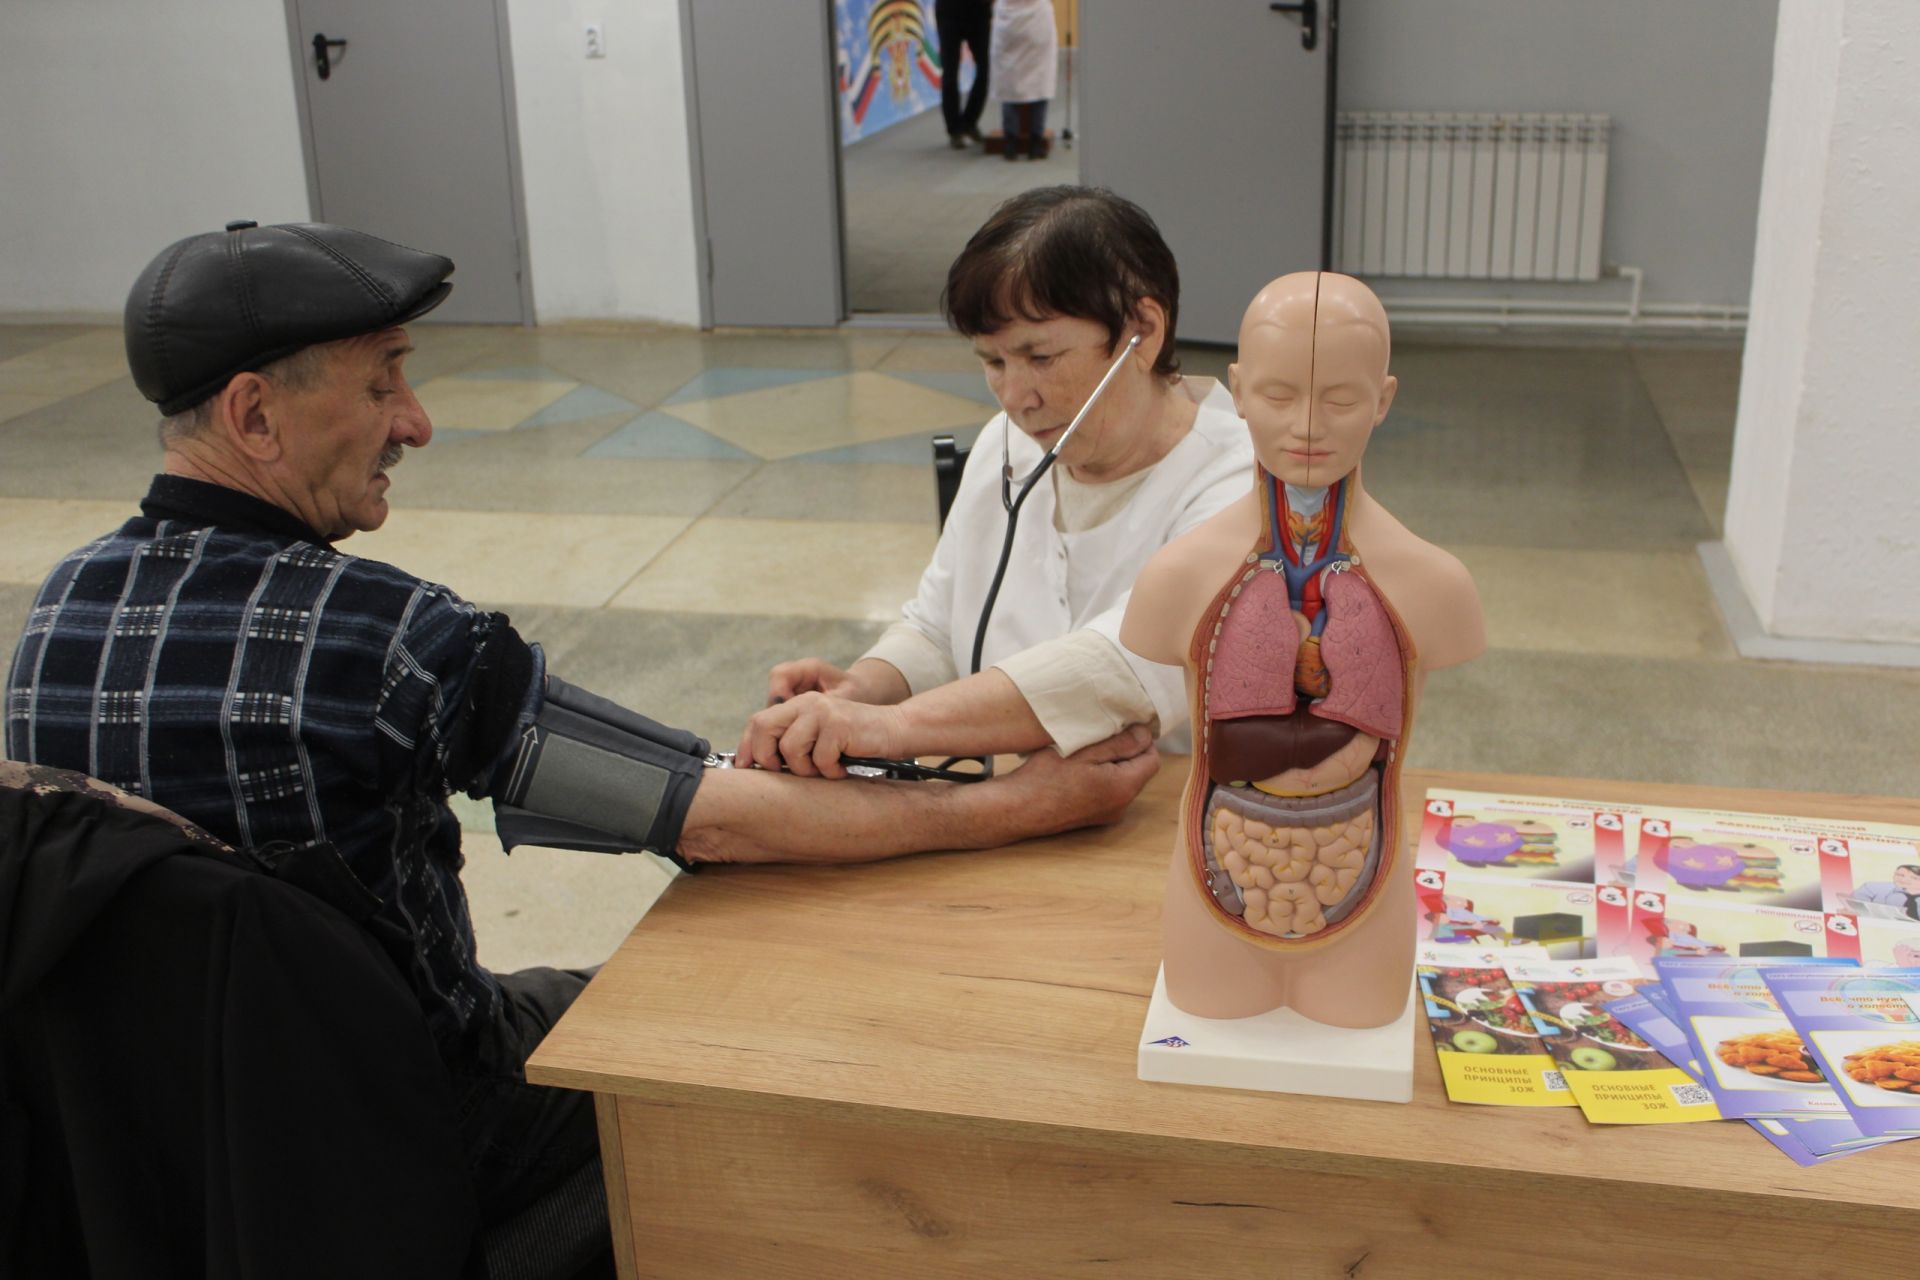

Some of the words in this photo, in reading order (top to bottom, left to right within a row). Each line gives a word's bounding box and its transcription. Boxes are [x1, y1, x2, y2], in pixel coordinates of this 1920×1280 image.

[1464, 1065, 1529, 1076] ОСНОВНЫЕ
[1464, 1074, 1533, 1085] ПРИНЦИПЫ
[1509, 1085, 1536, 1094] ЗОЖ
[1592, 1084, 1657, 1092] ОСНОВНЫЕ
[1595, 1093, 1663, 1101] ПРИНЦИПЫ
[1642, 1102, 1669, 1110] ЗОЖ
